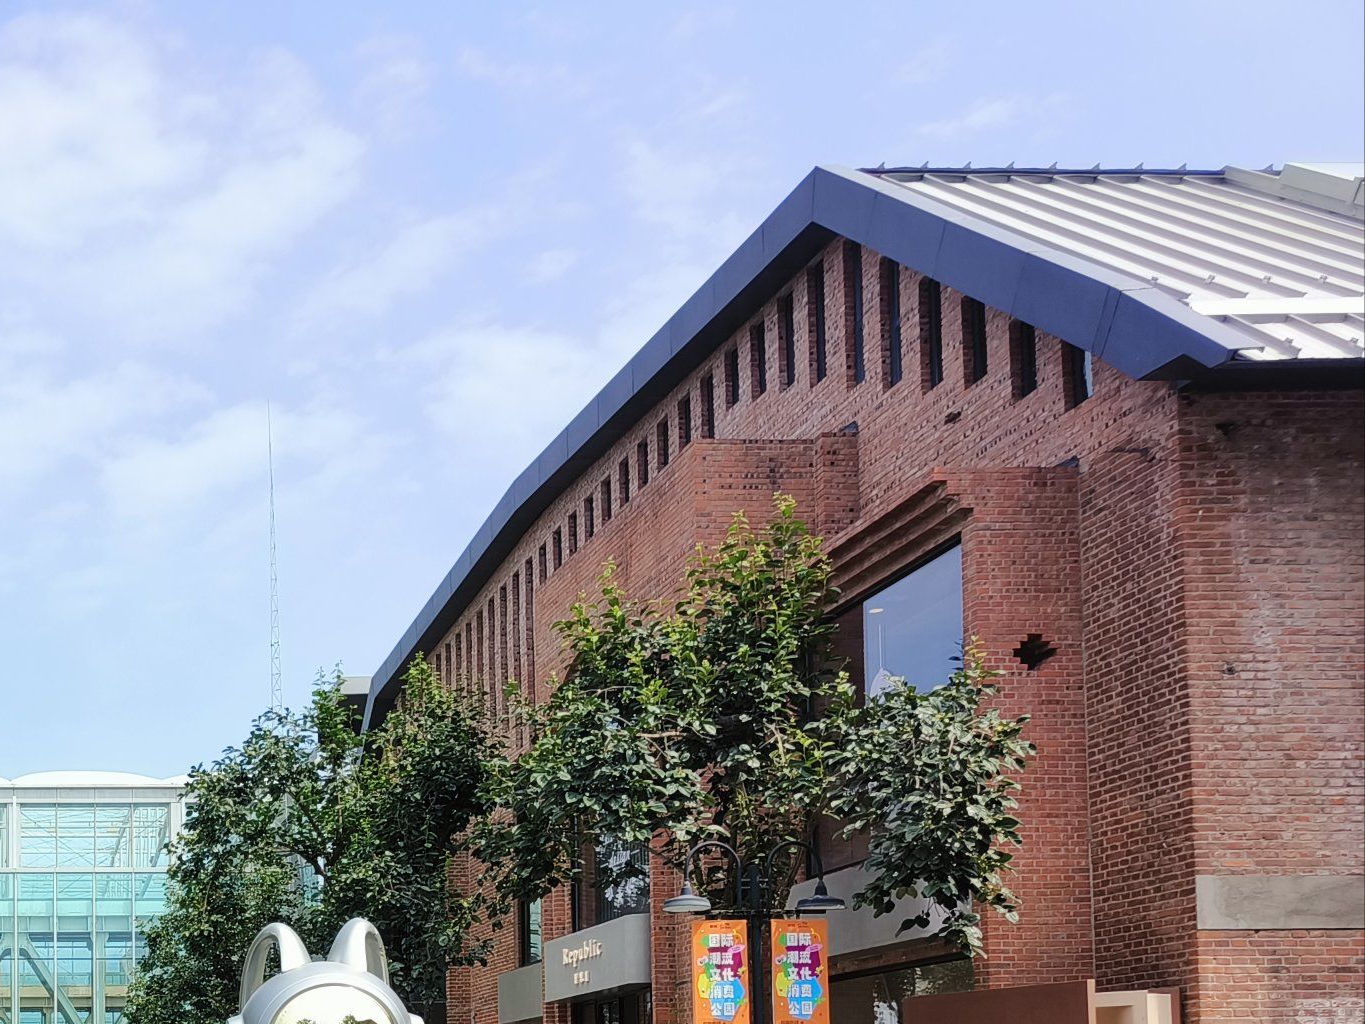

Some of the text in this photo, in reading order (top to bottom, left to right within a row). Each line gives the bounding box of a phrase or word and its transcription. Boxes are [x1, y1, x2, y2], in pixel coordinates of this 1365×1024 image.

[709, 933, 733, 948] 国际
[786, 932, 811, 947] 国际
[562, 940, 603, 968] Republic
[710, 952, 734, 965] 潮流
[787, 951, 812, 964] 潮流
[710, 968, 734, 981] 文化
[788, 967, 812, 980] 文化
[710, 984, 734, 999] 消费
[788, 984, 812, 998] 消费
[711, 1002, 735, 1016] 公园
[789, 1001, 813, 1015] 公园
